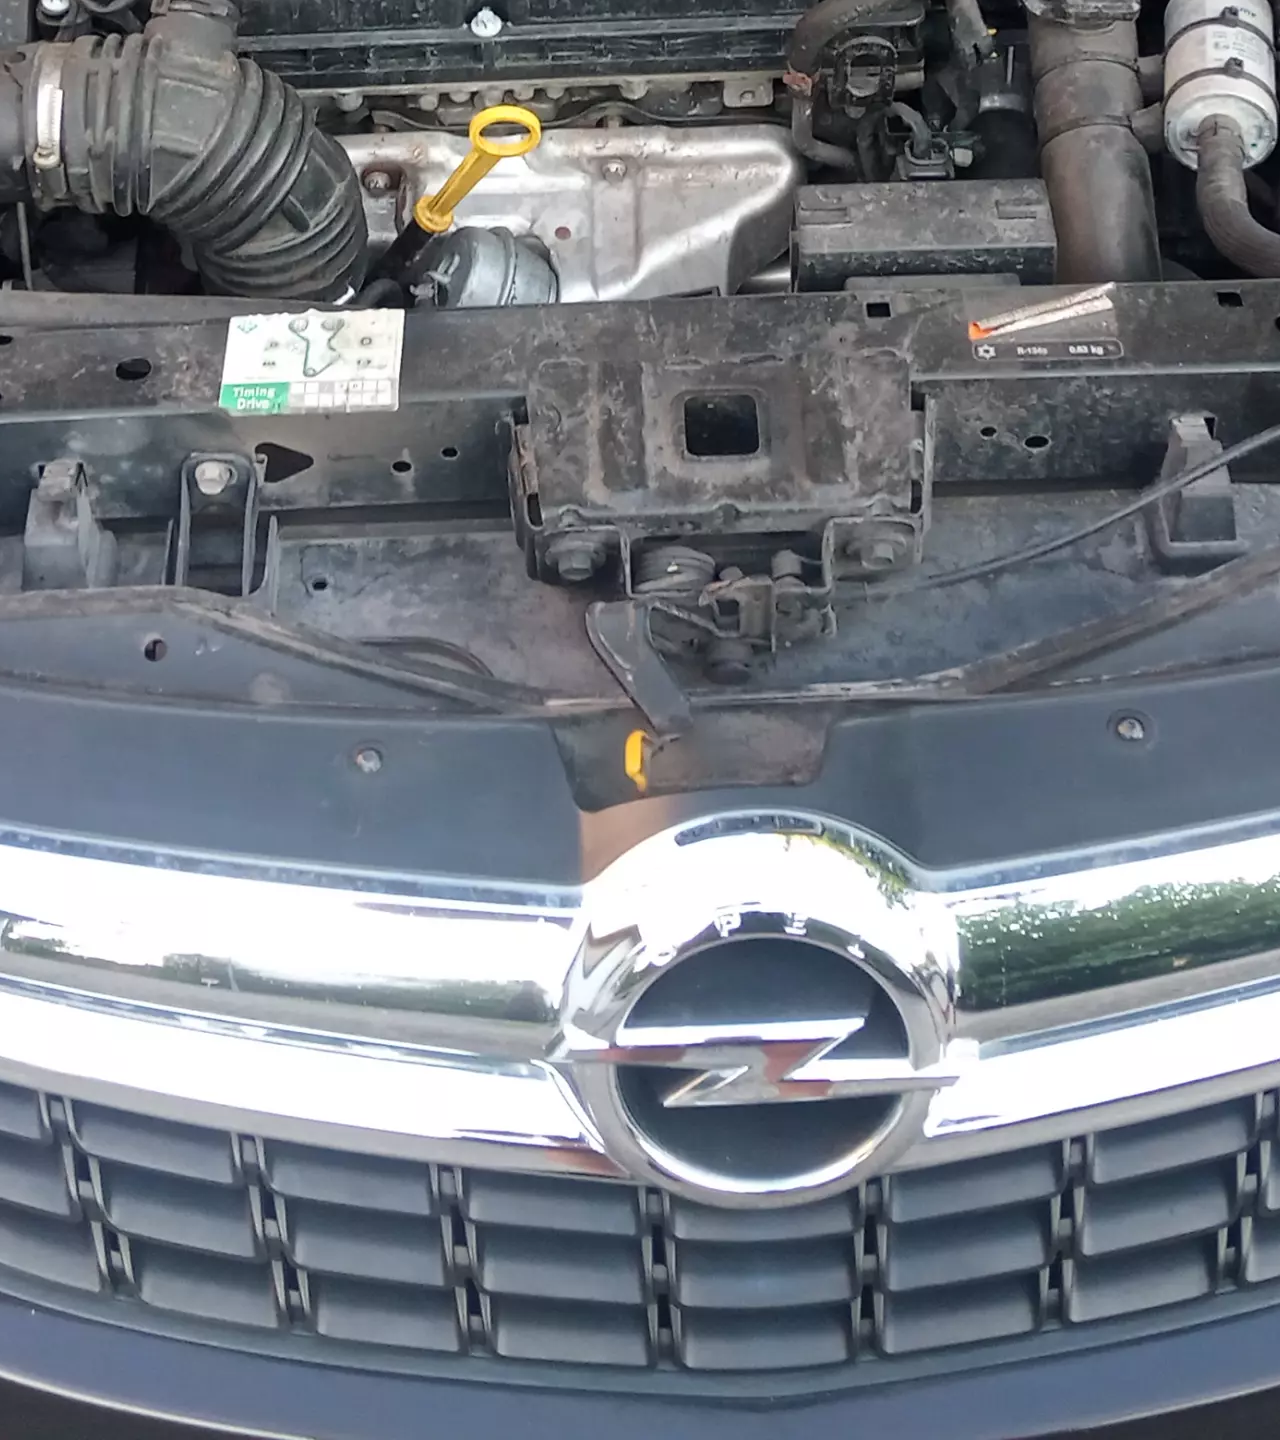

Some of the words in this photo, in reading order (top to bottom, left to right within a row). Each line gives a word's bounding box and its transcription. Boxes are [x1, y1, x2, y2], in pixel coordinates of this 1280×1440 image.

[1090, 344, 1105, 356] kg
[232, 386, 277, 400] Timing
[236, 396, 270, 410] Drive
